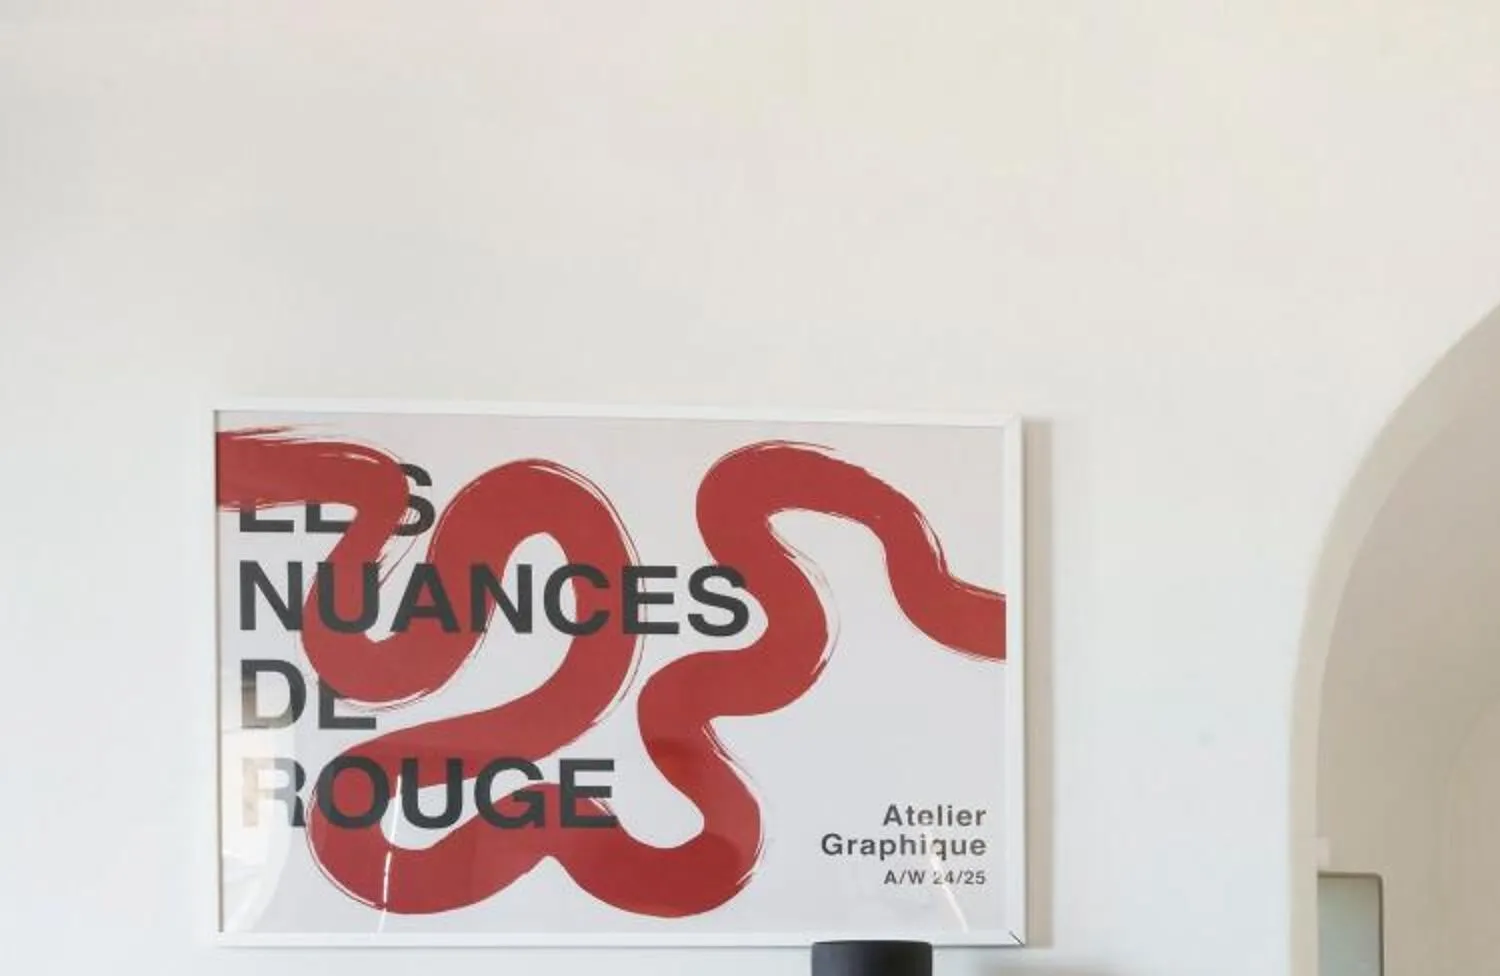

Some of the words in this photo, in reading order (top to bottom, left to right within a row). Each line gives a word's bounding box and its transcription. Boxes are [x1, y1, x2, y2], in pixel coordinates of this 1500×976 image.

[239, 561, 750, 637] NUANCES
[242, 756, 618, 830] ROUGE
[882, 804, 987, 826] Atelier
[821, 833, 987, 860] Graphique
[883, 869, 925, 885] A/W
[932, 869, 986, 885] 24/25
